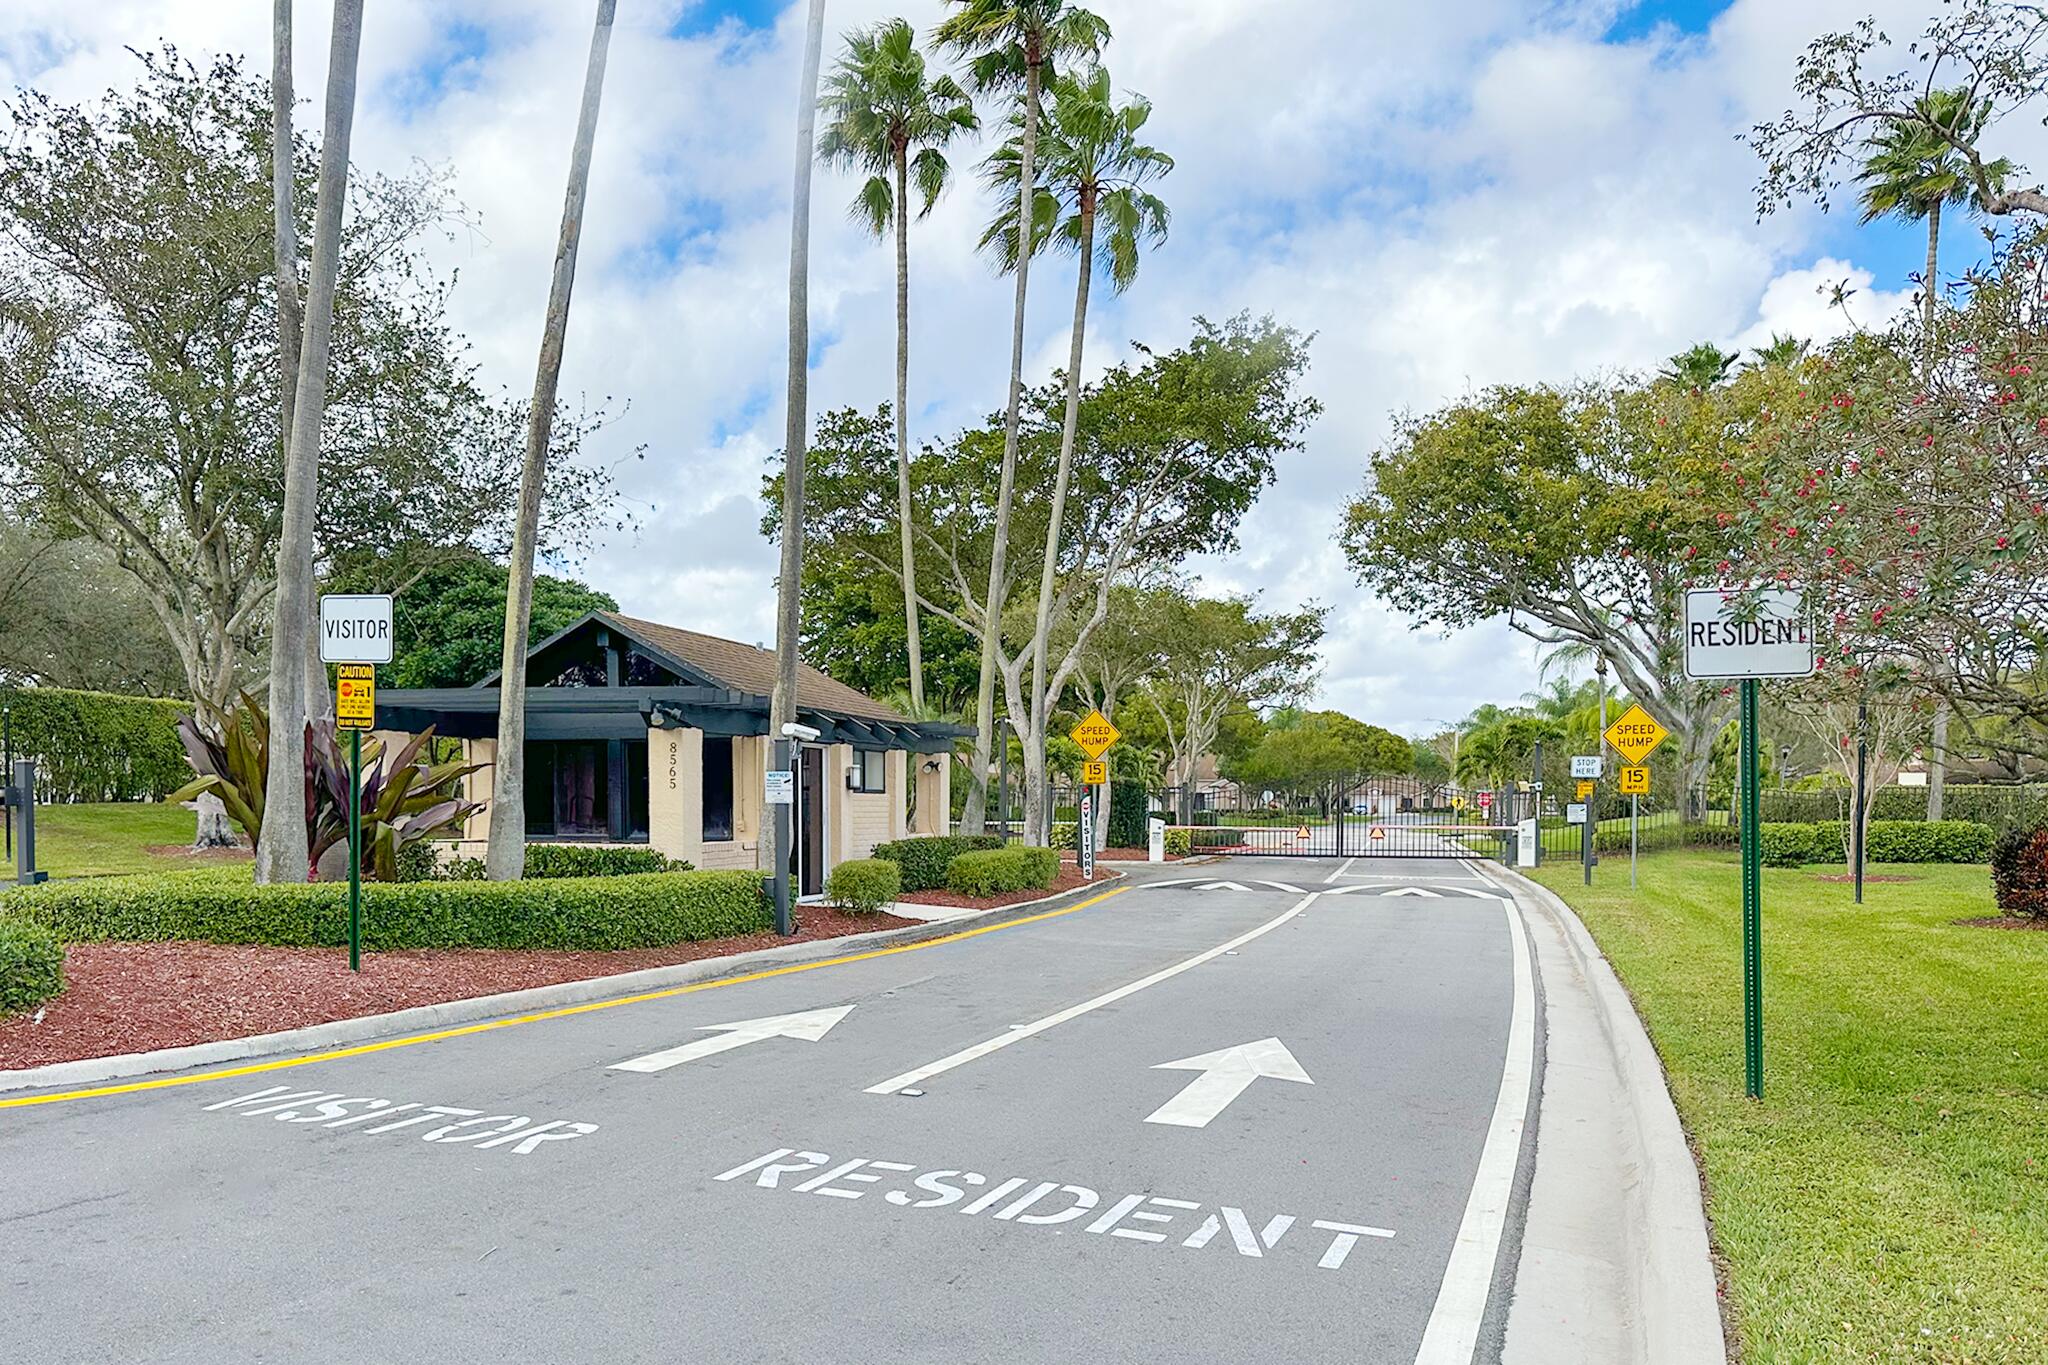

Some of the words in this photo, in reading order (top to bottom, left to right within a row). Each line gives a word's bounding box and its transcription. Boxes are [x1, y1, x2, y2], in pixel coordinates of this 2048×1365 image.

[325, 619, 388, 639] VISITOR
[340, 665, 372, 678] CAUTION
[1081, 726, 1111, 735] SPEED
[1617, 724, 1655, 735] SPEED
[1082, 737, 1109, 746] HUMP
[1618, 737, 1653, 747] HUMP
[669, 742, 677, 790] 8565
[1088, 764, 1101, 775] 15
[1577, 759, 1596, 767] STOP
[1627, 769, 1644, 783] 15
[1083, 811, 1091, 876] VISITORS
[202, 1086, 600, 1155] VISITOR
[712, 1148, 1397, 1270] RESIDENT
